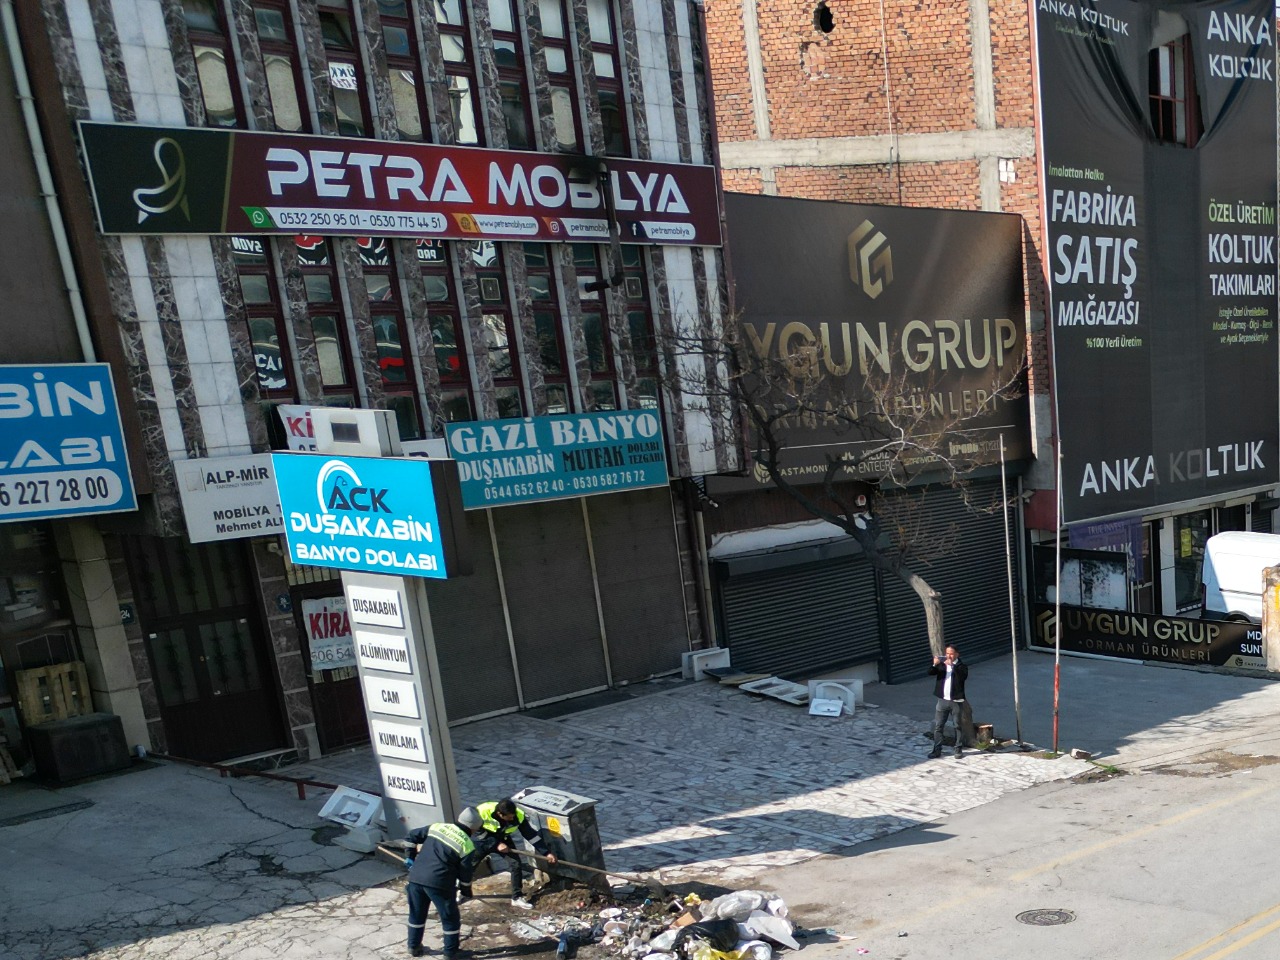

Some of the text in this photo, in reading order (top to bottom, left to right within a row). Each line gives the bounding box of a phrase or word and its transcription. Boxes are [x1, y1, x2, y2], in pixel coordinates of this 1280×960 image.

[1039, 0, 1076, 19] ANKA
[1080, 6, 1129, 37] KOLTUK
[1207, 10, 1273, 47] ANKA
[1209, 53, 1273, 82] KOLTUK
[265, 147, 691, 214] PETRA MOBLYA
[280, 212, 308, 225] 0532
[311, 213, 331, 226] 250
[333, 213, 347, 226] 95
[369, 214, 396, 227] 0530
[1051, 185, 1137, 227] FABRİKA
[1208, 199, 1275, 225] ÖZEL ÜRETİM
[570, 223, 609, 235] petramobily
[1208, 233, 1275, 264] KOLTUK
[1054, 234, 1139, 300] SATIŞ
[1209, 273, 1276, 296] TAKIMLARI
[1058, 293, 1140, 327] MAĞAZASI
[744, 318, 1018, 379] YGUN GRUP
[451, 413, 658, 455] GAZİ BANYO
[205, 465, 270, 485] ALP-MİR
[458, 441, 660, 485] DUŞAKABİN MUTFAK DOLABI
[1079, 440, 1266, 497] ANKA KOLTUK
[14, 480, 50, 506] 227
[56, 478, 82, 501] 28
[85, 475, 109, 499] 00
[484, 486, 512, 500] 0544
[514, 483, 535, 496] 652
[536, 481, 550, 494] 62
[551, 480, 565, 492] 40
[572, 475, 598, 490] 0530
[600, 473, 619, 487] 582
[619, 471, 632, 484] 76
[634, 470, 646, 482] 72
[213, 505, 269, 521] MOBİLYA
[328, 486, 393, 514] ACK
[215, 520, 263, 534] Mehmet
[290, 512, 434, 543] DUŞAKABİN
[296, 543, 438, 571] BANYO DOLABI
[352, 598, 398, 616] DUŞAKABİN
[1066, 609, 1221, 644] UYGUN GRUP
[1246, 630, 1262, 642] MD
[360, 643, 408, 664] ALÜMİNYUM
[1086, 639, 1211, 662] ORMAN ÜRÜNLERİ
[381, 689, 401, 705] CAM
[378, 732, 419, 751] KUMLAMA
[387, 775, 428, 794] AKSESUAR
